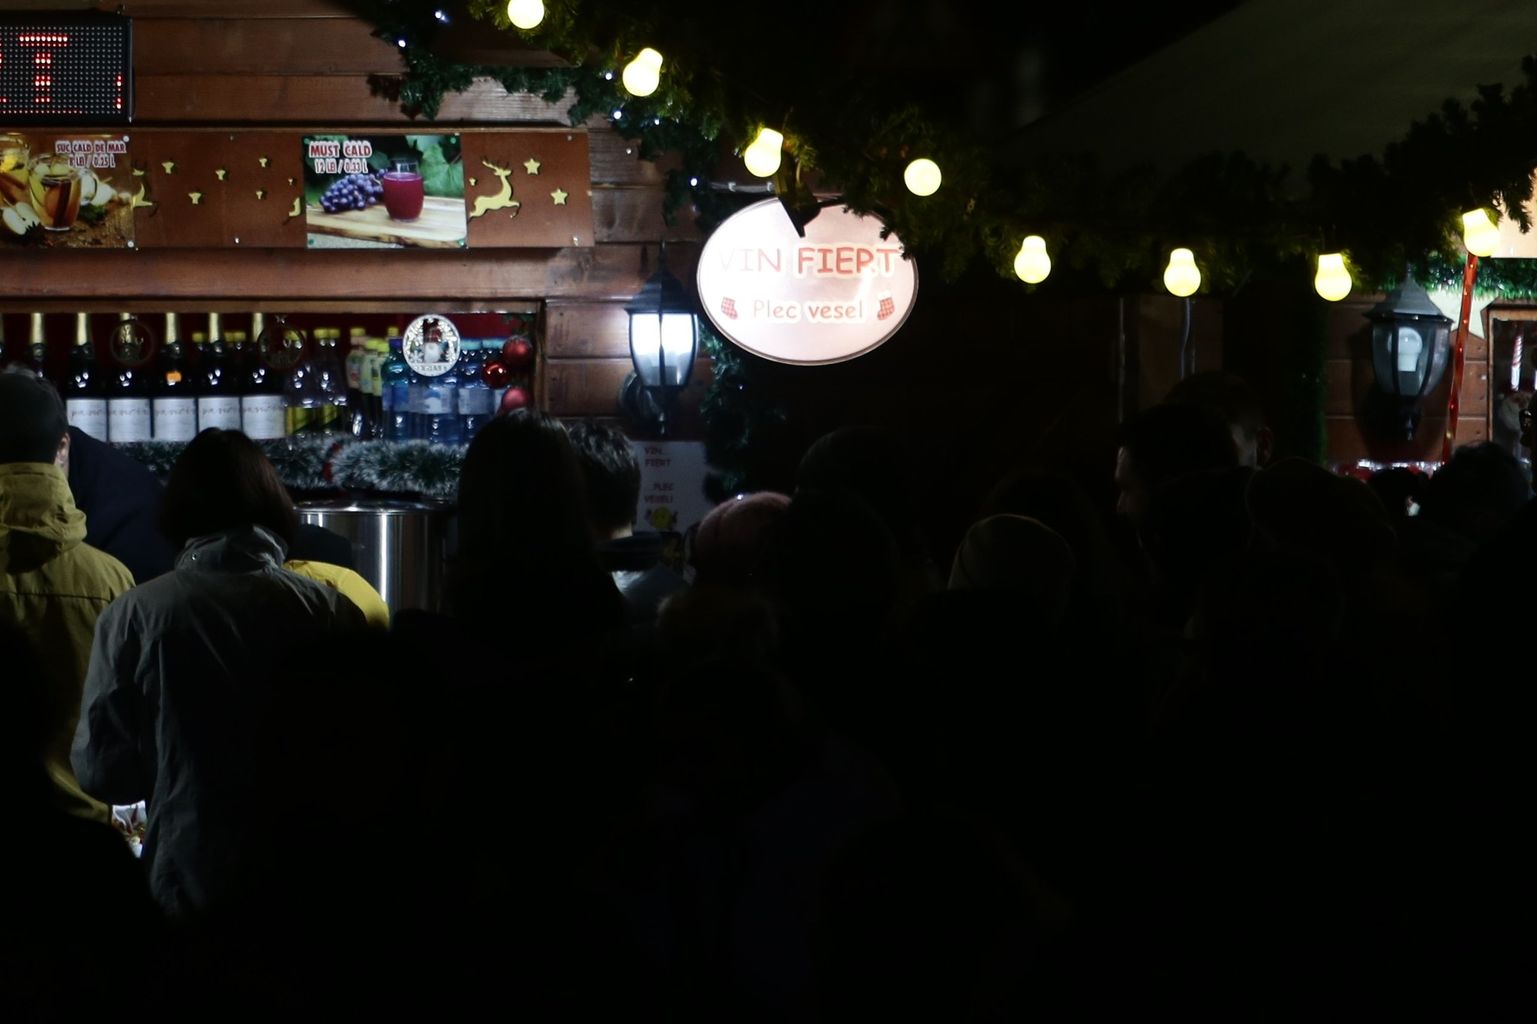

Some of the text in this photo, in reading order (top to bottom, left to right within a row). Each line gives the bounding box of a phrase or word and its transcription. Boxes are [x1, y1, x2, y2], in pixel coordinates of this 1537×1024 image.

[56, 142, 70, 153] SUC
[73, 142, 92, 153] CALD
[95, 142, 105, 153] DE
[310, 143, 371, 157] MUST CALD
[327, 160, 336, 172] LEI
[719, 246, 900, 274] VIN FIERT
[752, 299, 864, 320] Plec vesel
